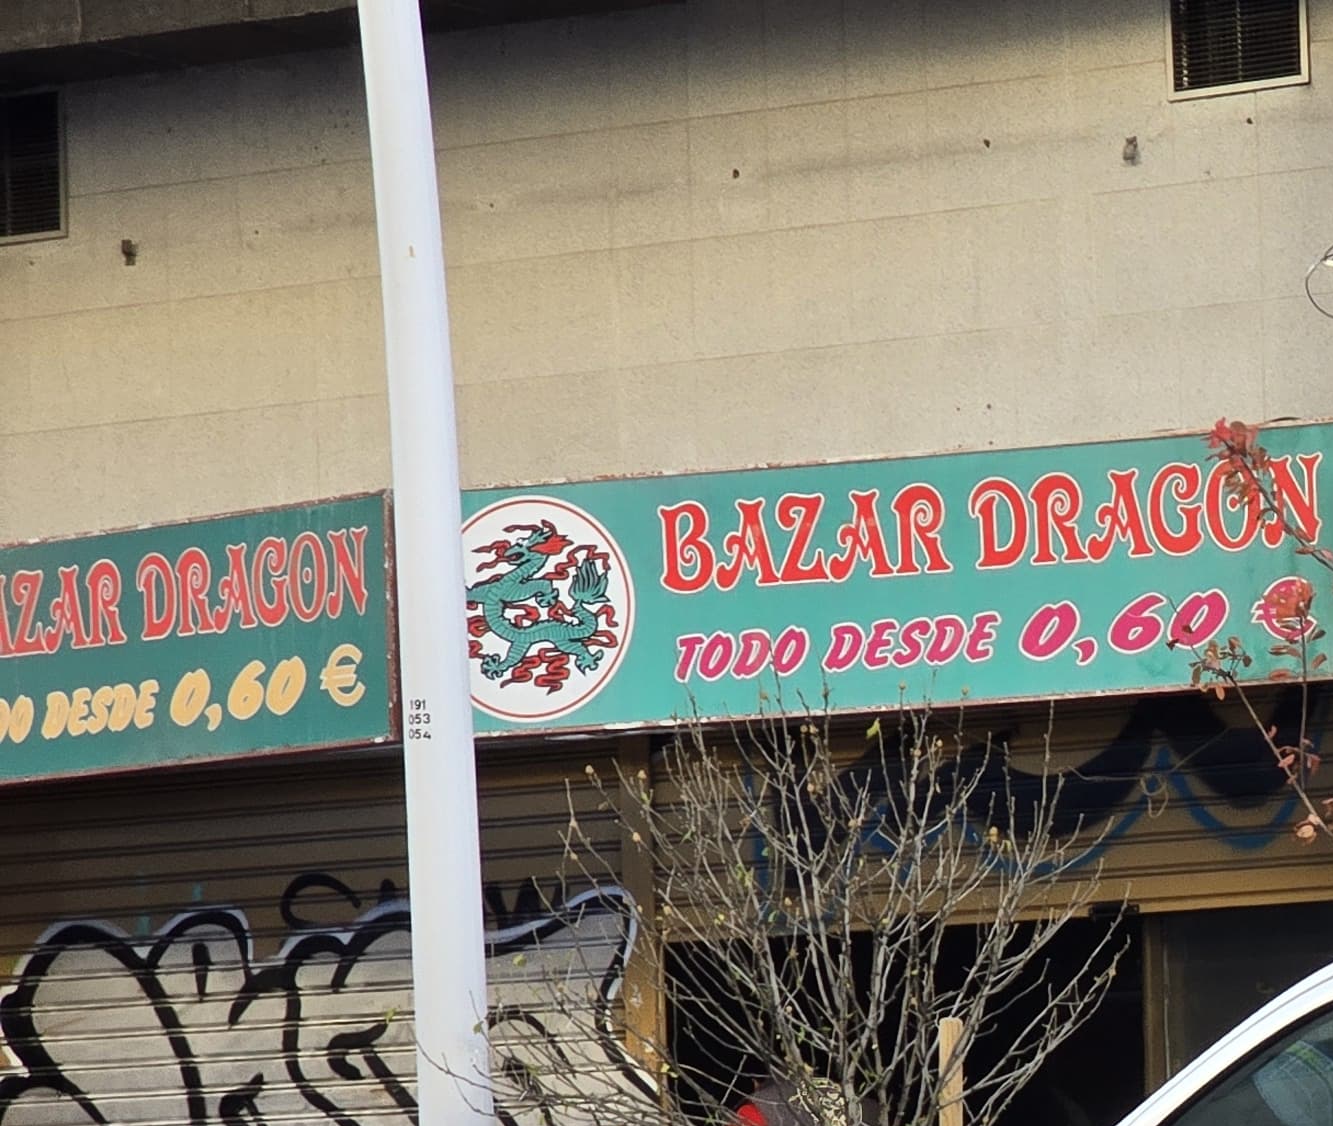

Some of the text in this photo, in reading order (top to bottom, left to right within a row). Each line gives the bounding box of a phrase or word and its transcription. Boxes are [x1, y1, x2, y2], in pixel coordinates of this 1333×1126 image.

[657, 451, 1324, 594] BAZAR DRAGON
[136, 525, 369, 641] DRAGON
[673, 627, 810, 684] TODO
[822, 610, 1002, 675] DESDE
[1016, 587, 1230, 667] 0,60
[41, 678, 160, 740] DESDE
[169, 655, 307, 732] 0,60
[319, 643, 367, 707] €
